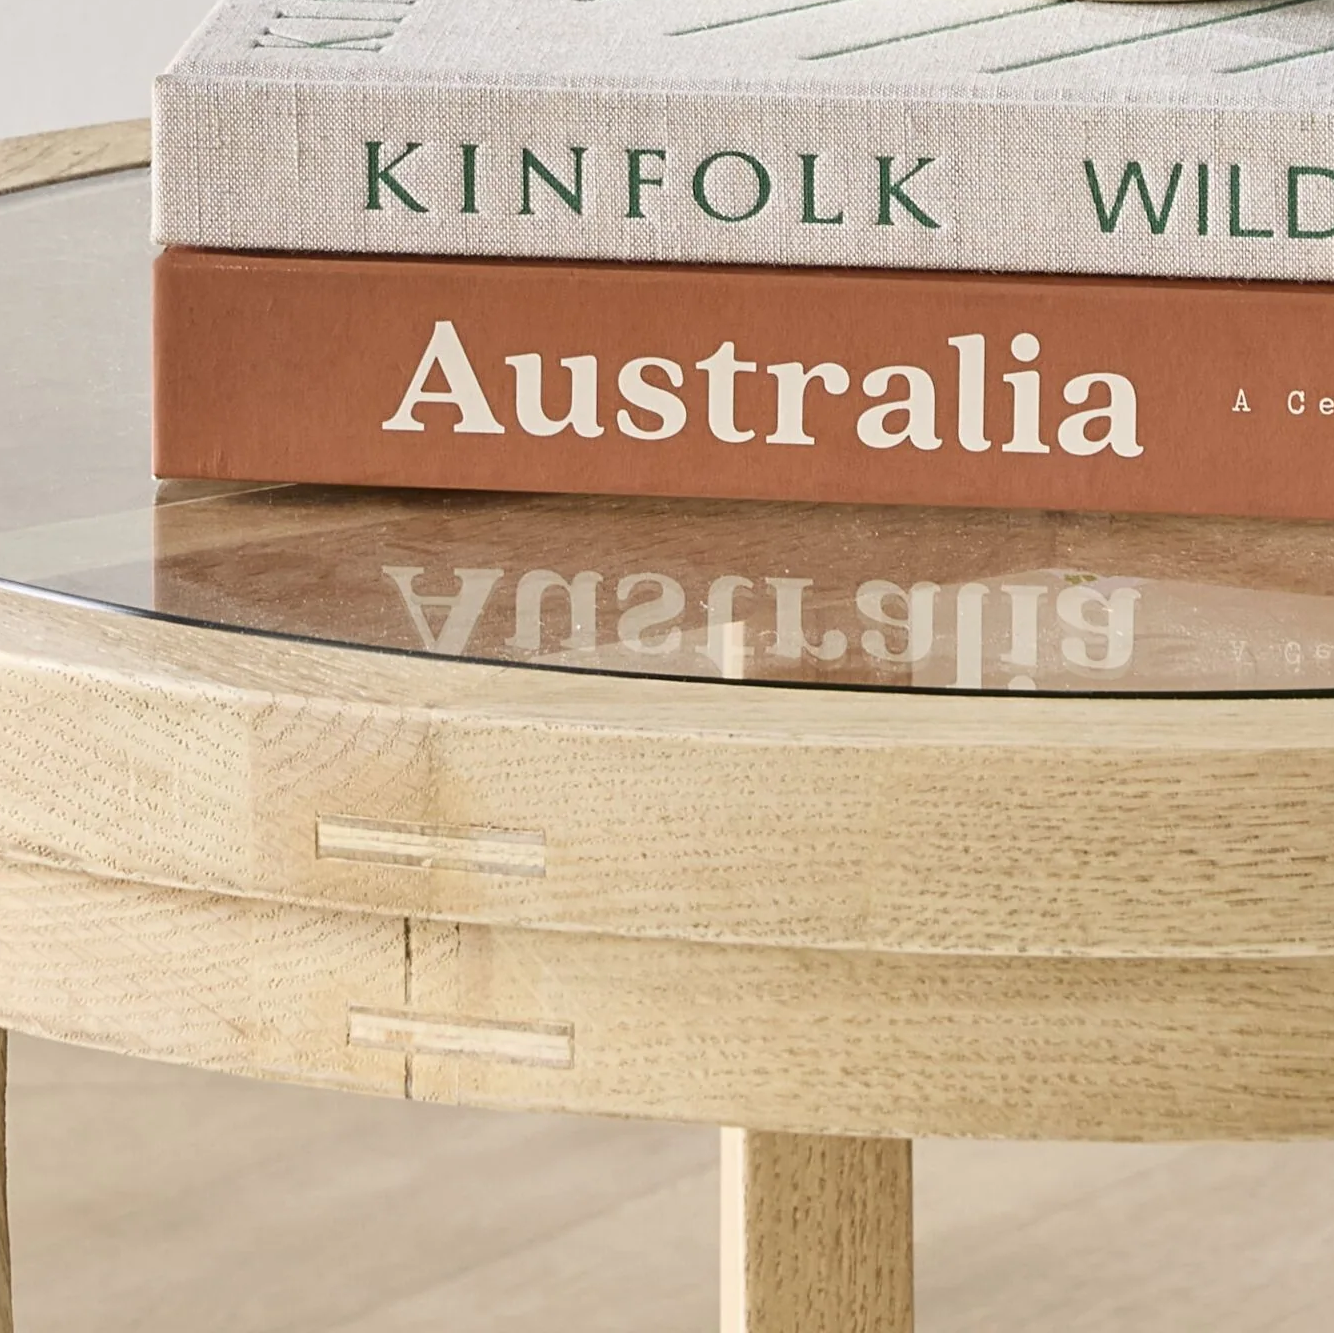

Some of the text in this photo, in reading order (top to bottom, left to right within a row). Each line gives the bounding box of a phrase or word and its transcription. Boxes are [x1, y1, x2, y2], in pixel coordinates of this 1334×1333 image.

[364, 140, 940, 229] KINFOLK
[381, 320, 1144, 457] Australia
[1230, 389, 1251, 414] A
